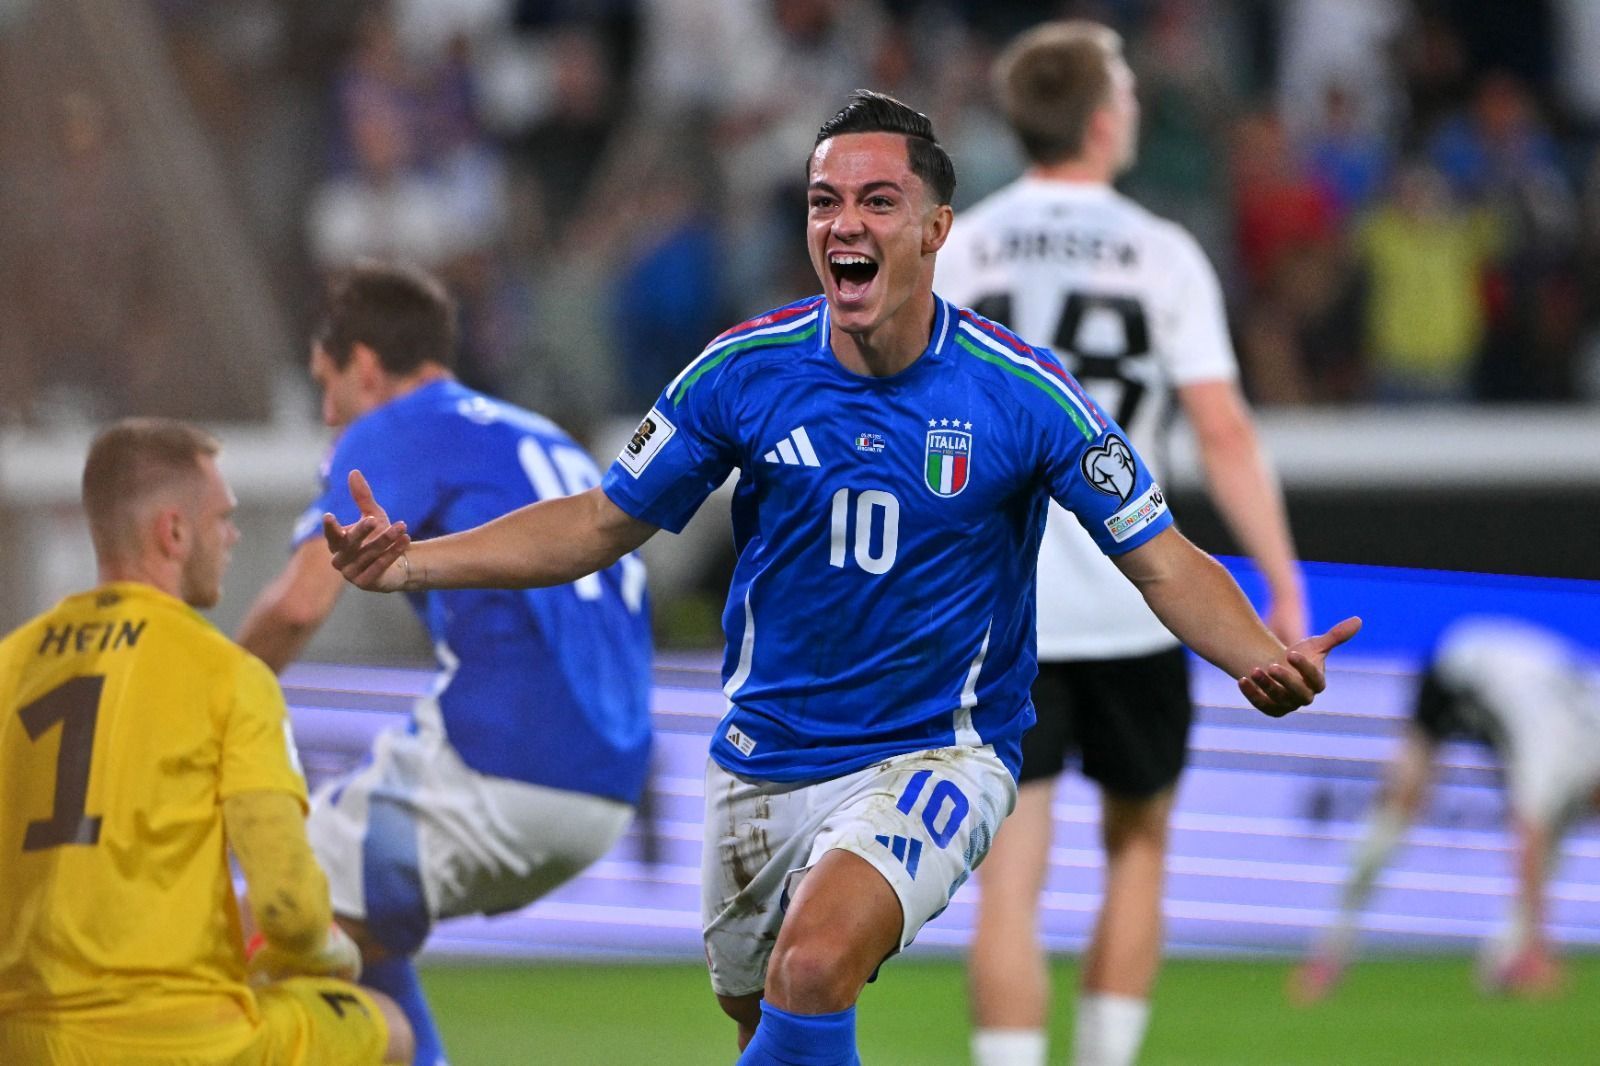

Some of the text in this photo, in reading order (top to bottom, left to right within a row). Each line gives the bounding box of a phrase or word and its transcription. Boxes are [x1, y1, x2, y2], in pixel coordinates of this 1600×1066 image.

[930, 434, 967, 450] ITALIA
[829, 486, 900, 575] 10
[38, 619, 147, 656] HEIN
[17, 673, 106, 852] 1
[896, 770, 970, 850] 10
